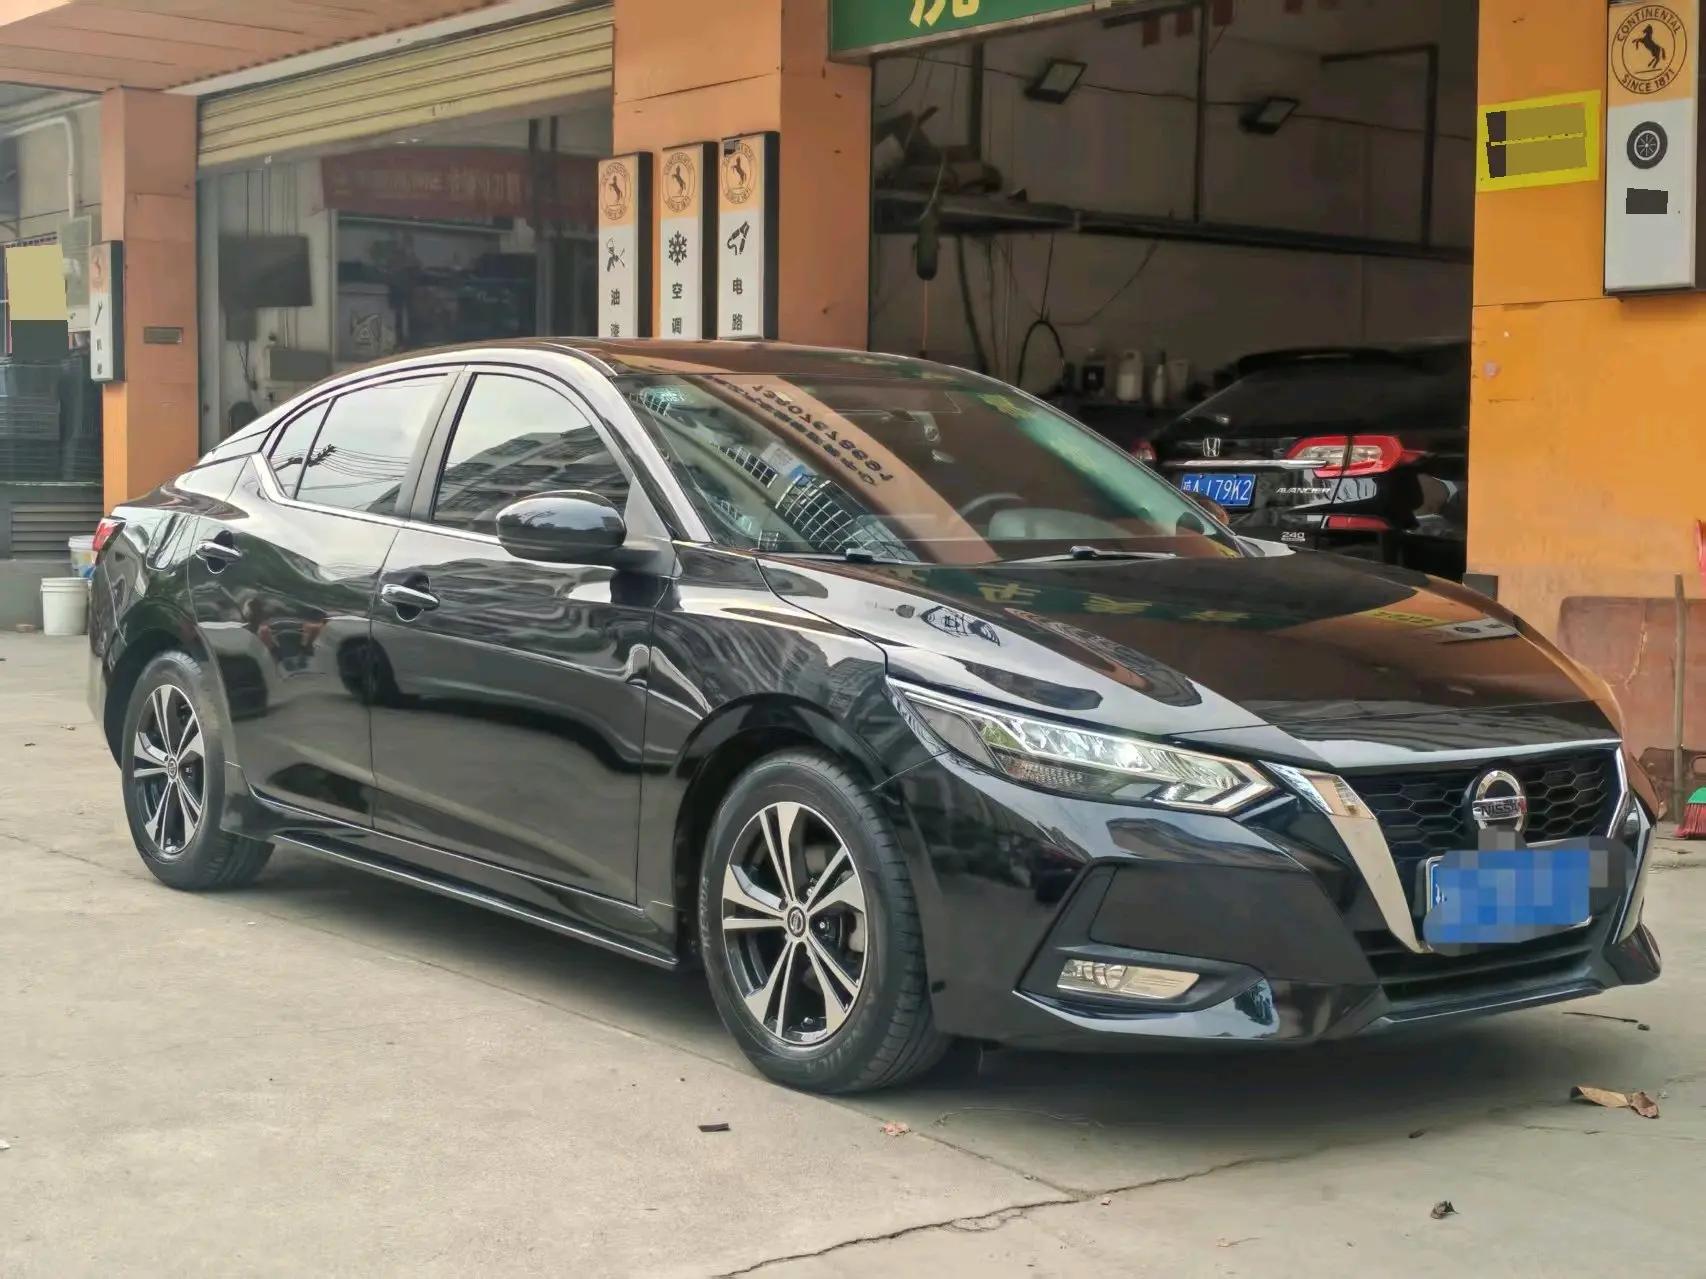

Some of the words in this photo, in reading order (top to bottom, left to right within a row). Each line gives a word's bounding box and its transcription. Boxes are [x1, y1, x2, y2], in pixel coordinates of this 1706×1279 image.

[1616, 8, 1681, 42] CONTINENTAL
[1622, 73, 1652, 92] SINCE
[1655, 68, 1675, 88] 1871
[672, 282, 683, 334] 空调
[732, 277, 743, 331] 电路
